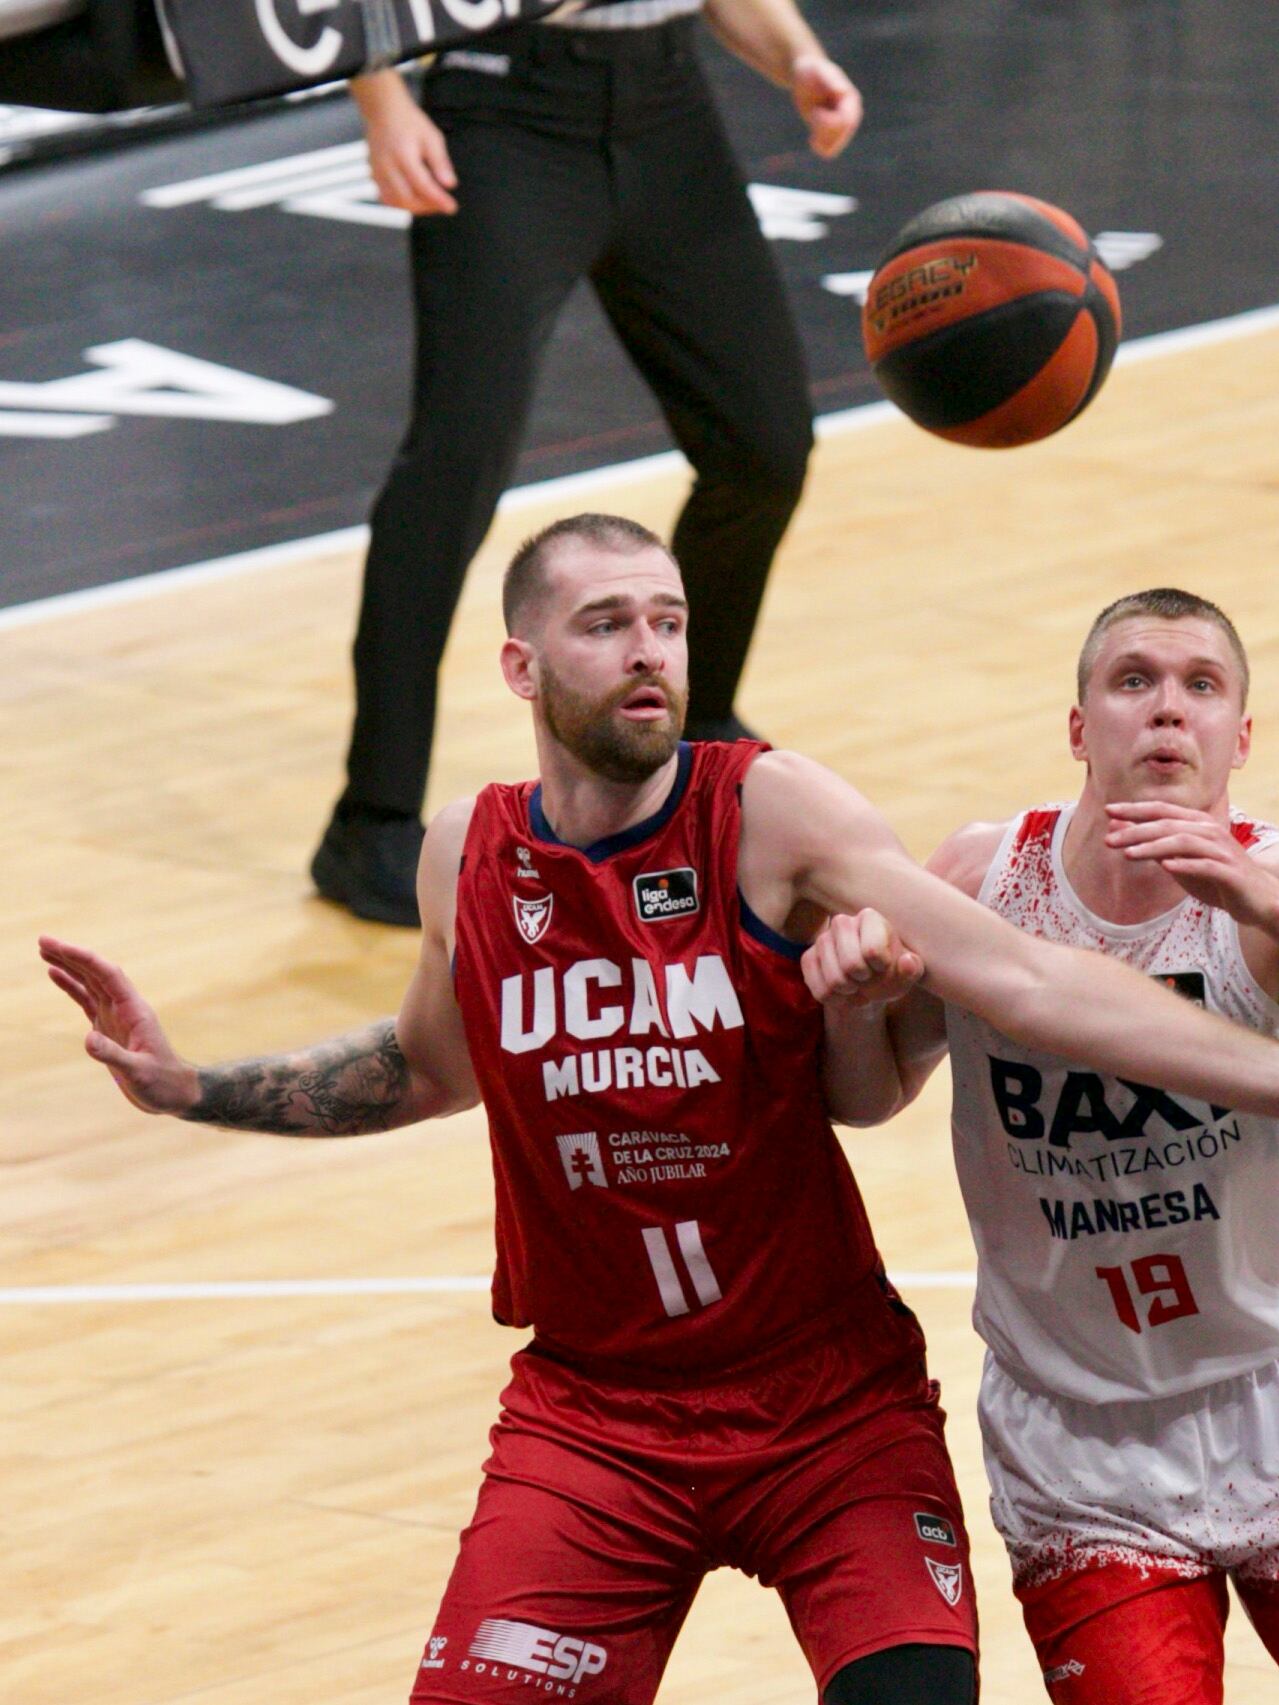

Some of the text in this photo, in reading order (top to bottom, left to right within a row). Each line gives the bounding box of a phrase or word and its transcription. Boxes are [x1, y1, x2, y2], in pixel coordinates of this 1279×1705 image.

[642, 888, 668, 904] liga
[644, 896, 695, 915] endesa
[501, 954, 745, 1055] UCAM
[542, 1046, 722, 1102] MURCIA
[987, 1053, 1234, 1149] BAX
[608, 1130, 692, 1147] CARAVACA
[613, 1142, 731, 1165] DE LA CRUZ 2024
[617, 1163, 707, 1185] AÑO JUBILAR
[1040, 1181, 1221, 1241] MANRESA
[641, 1219, 723, 1318] 11
[1095, 1253, 1200, 1335] 19
[921, 1525, 948, 1541] acb
[499, 1621, 608, 1684] ESP
[460, 1659, 577, 1699] SOLUTIONS
